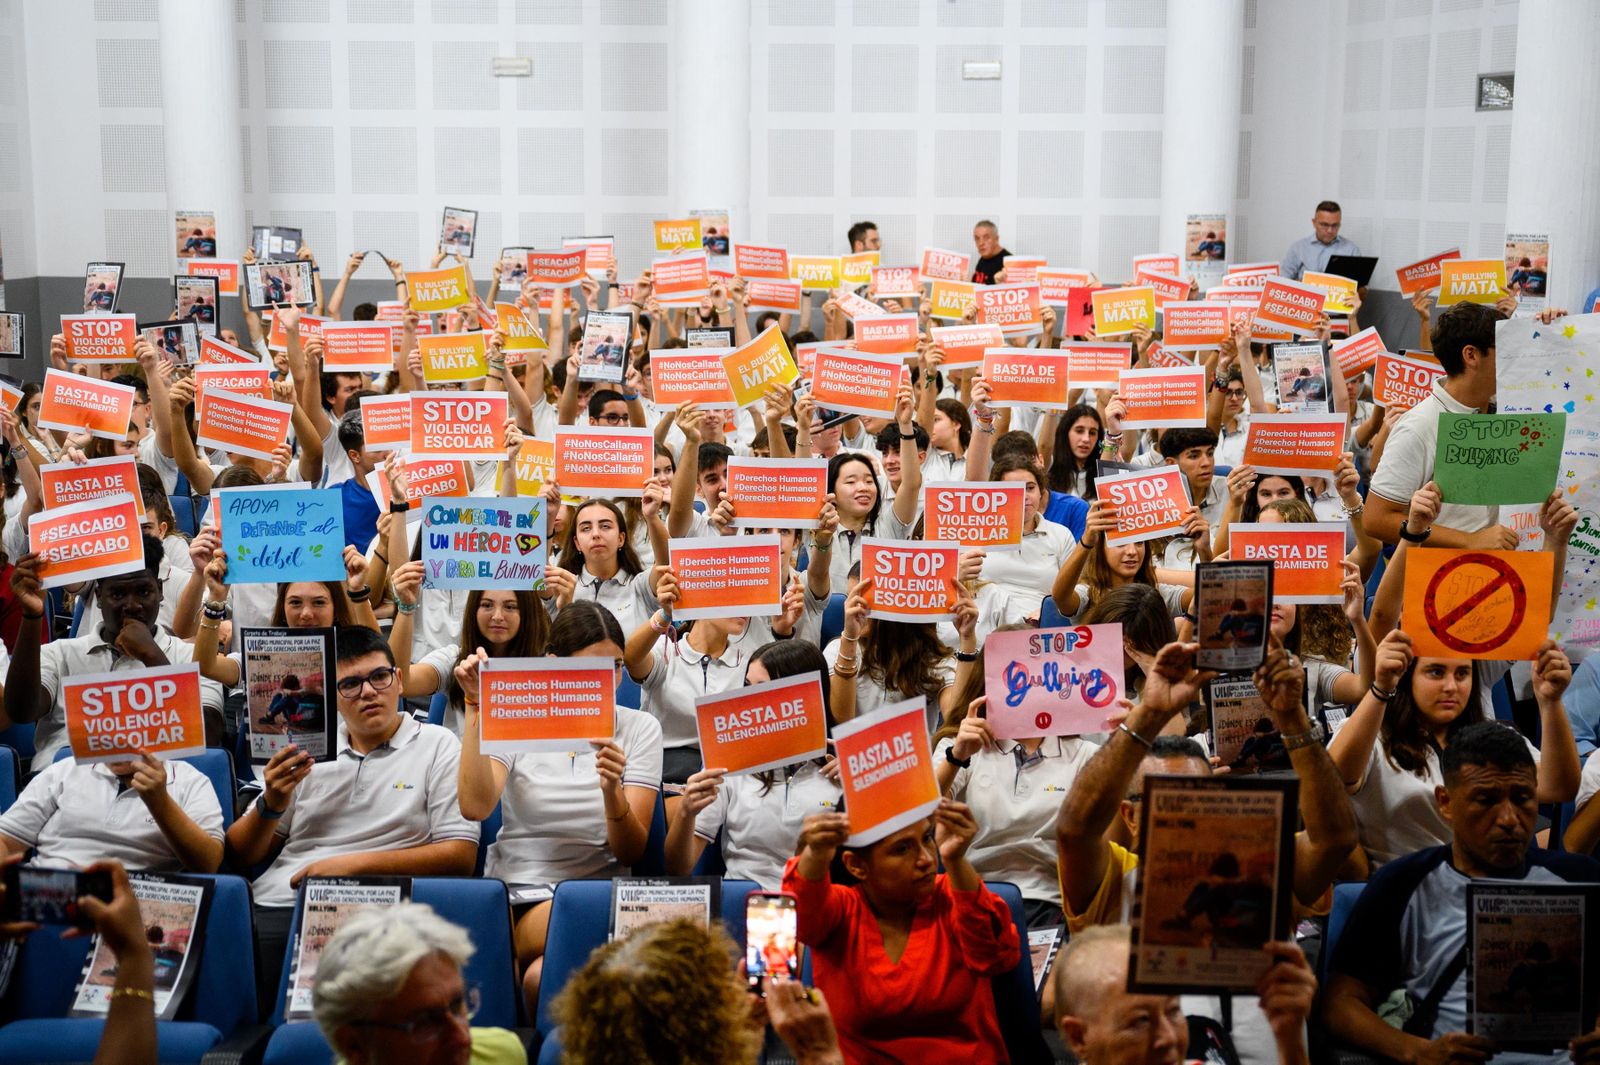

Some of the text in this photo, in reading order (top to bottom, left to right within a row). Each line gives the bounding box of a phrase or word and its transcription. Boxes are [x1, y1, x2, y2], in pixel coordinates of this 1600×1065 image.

[661, 232, 695, 243] MATA
[532, 256, 580, 267] #SEACABO
[929, 253, 962, 265] STOP
[532, 267, 580, 278] #SEACABO
[797, 269, 833, 281] MATA
[877, 269, 913, 279] STOP
[1405, 262, 1437, 277] BASTA
[1451, 272, 1498, 281] EL BULLYING
[416, 288, 461, 302] MATA
[1451, 280, 1499, 296] MATA
[983, 290, 1029, 305] STOP
[1268, 287, 1318, 309] #SEACABO
[984, 313, 1033, 325] ESCOLAR
[1103, 307, 1149, 323] MATA
[1264, 301, 1314, 322] #SEACABO
[71, 321, 123, 337] STOP
[863, 325, 909, 335] BASTA DE
[942, 331, 992, 342] BASTA DE
[72, 338, 124, 346] VIOLENCIA
[74, 346, 127, 356] ESCOLAR
[429, 346, 475, 356] EL BULLYING
[431, 355, 478, 369] MATA
[738, 343, 781, 375] EL BULLYING
[741, 352, 789, 390] MATA
[823, 359, 892, 376] #NoNosCallaran
[993, 364, 1055, 376] BASTA DE
[202, 377, 262, 388] #SEACABO
[820, 370, 892, 388] #NoNosCallarán
[992, 375, 1056, 385] SILENCIAMIENTO
[1163, 381, 1197, 389] Humanos
[55, 385, 120, 406] BASTA DE
[820, 381, 889, 398] #NoNosCallarán
[1384, 378, 1432, 399] VIOLENC
[53, 396, 118, 414] SILENCIAMIENTO
[1383, 388, 1420, 407] ESCO
[208, 402, 281, 424] #Derechos Humanos
[368, 407, 400, 416] #Derechos
[423, 401, 492, 422] STOP
[207, 411, 280, 433] #Derechos Humanos
[368, 415, 401, 424] #Derechos
[206, 419, 277, 442] #Derechos Humanos
[369, 423, 401, 432] #Derechos
[424, 424, 492, 434] VIOLENCIA
[1255, 429, 1336, 438] #Derechos Humanos
[1449, 418, 1521, 440] STOP
[424, 435, 494, 449] ESCOLAR
[564, 439, 643, 450] #NoNosCallaran
[1253, 438, 1297, 447] #Derechos
[563, 451, 644, 462] #NoNosCallarán
[1252, 446, 1333, 457] #Derechos Humanos
[406, 463, 454, 481] EACABO
[564, 464, 643, 474] #NoNosCallarán
[54, 475, 124, 494] BASTA DE
[734, 473, 818, 483] #Derechos Humanos
[407, 479, 458, 498] EACABO
[734, 483, 818, 493] #Derechos Humanos
[1109, 478, 1169, 505] STOP
[733, 493, 816, 503] #Derechos Humanos
[937, 491, 1008, 513] STOP
[229, 497, 279, 516] APOYA
[309, 517, 339, 535] al
[937, 514, 1008, 526] VIOLENCIA
[39, 514, 126, 542] #SEACABO
[937, 527, 1009, 541] ESCOLAR
[430, 527, 512, 554] UN HÉROE
[38, 535, 129, 562] #SEACABO
[1244, 545, 1328, 559] BASTA DE
[252, 544, 303, 569] débil
[679, 555, 770, 566] #Derechos Humanos
[874, 550, 945, 577] STOP
[428, 559, 444, 578] Y
[446, 559, 475, 578] PARA
[478, 560, 493, 577] EL
[679, 566, 770, 577] #Derechos Humanos
[1273, 560, 1329, 569] CIAMIENTO
[679, 577, 769, 590] #Derechos Humanos
[874, 576, 946, 592] VIOLENCIA
[874, 591, 947, 609] ESCOLAR
[1029, 631, 1079, 655] STOP
[490, 680, 601, 691] #Derechos Humanos
[81, 679, 177, 716] STOP
[490, 692, 602, 704] #Derechos Humanos
[490, 706, 601, 718] #Derechos Humanos
[713, 698, 805, 732] BASTA DE
[83, 709, 181, 734] VIOLENCIA
[716, 715, 808, 744] SILENCIAMIENTO
[87, 725, 185, 751] ESCOLAR
[847, 732, 915, 776] BASTA DE
[852, 754, 919, 793] SILENCIAMIENTO
